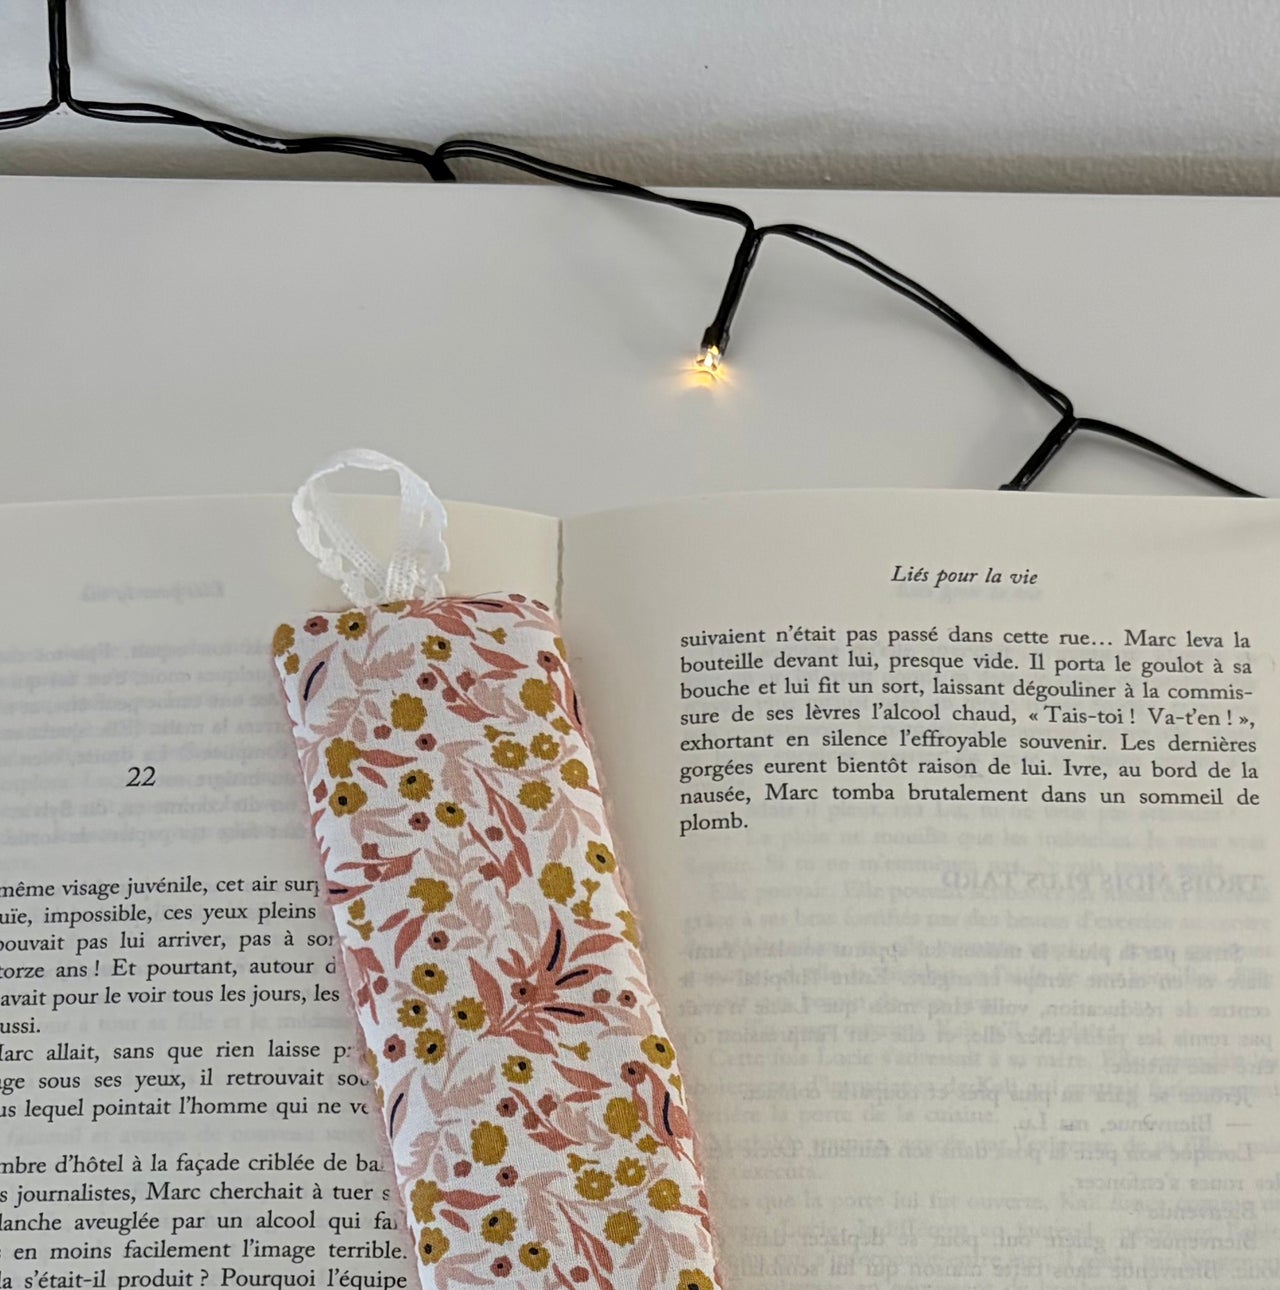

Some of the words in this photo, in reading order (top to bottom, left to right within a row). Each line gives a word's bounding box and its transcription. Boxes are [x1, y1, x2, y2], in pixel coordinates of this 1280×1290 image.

[890, 565, 930, 583] Liés
[933, 569, 979, 589] pour
[984, 567, 1003, 584] la
[1009, 568, 1039, 585] vie
[680, 628, 766, 648] suivaient
[776, 624, 837, 643] n'était
[845, 629, 878, 648] pas
[887, 626, 939, 648] passé
[948, 624, 993, 644] dans
[1003, 631, 1049, 645] cette
[1123, 628, 1177, 648] Marc
[1185, 630, 1225, 648] leva
[1233, 630, 1251, 649] la
[680, 651, 764, 674] bouteille
[773, 650, 839, 669] devant
[847, 649, 880, 671] lui,
[888, 655, 965, 674] presque
[972, 651, 1019, 670] vide.
[1028, 652, 1046, 671] Il
[1054, 657, 1106, 677] porta
[1114, 654, 1132, 673] le
[1140, 655, 1204, 679] goulot
[1212, 657, 1224, 674] à
[1232, 662, 1253, 675] sa
[679, 678, 750, 700] bouche
[758, 680, 778, 695] et
[783, 676, 810, 695] lui
[817, 675, 841, 694] fit
[847, 682, 874, 694] un
[881, 680, 925, 698] sort,
[932, 676, 1006, 696] laissant
[1012, 678, 1117, 703] dégouliner
[1124, 682, 1136, 699] à
[1142, 681, 1160, 699] la
[1167, 683, 1253, 701] commis-
[680, 732, 775, 752] exhortant
[785, 735, 810, 748] en
[822, 728, 888, 747] silence
[899, 728, 1008, 754] l'effroyable
[1019, 733, 1107, 751] souvenir.
[1120, 732, 1156, 752] Les
[1167, 733, 1257, 753] dernières
[125, 765, 156, 788] 22
[679, 759, 754, 784] gorgées
[763, 759, 828, 775] eurent
[836, 755, 909, 774] bientôt
[917, 757, 978, 775] raison
[987, 756, 1011, 776] de
[1020, 757, 1053, 776] lui.
[1062, 758, 1108, 781] Ivre,
[1118, 765, 1142, 778] au
[1150, 759, 1198, 779] bord
[1207, 760, 1232, 779] de
[1241, 761, 1259, 780] la
[679, 785, 752, 806] nausée,
[764, 782, 819, 801] Marc
[831, 781, 896, 801] tomba
[907, 782, 1029, 803] brutalement
[1041, 784, 1087, 804] dans
[1099, 791, 1126, 804] un
[1139, 787, 1224, 806] sommeil
[1236, 787, 1260, 806] de
[679, 810, 749, 838] plomb.
[61, 879, 121, 901] visage
[123, 874, 209, 901] juvénile,
[215, 878, 245, 893] cet
[251, 875, 279, 892] air
[43, 903, 153, 929] impossible,
[163, 907, 193, 921] ces
[201, 907, 249, 926] yeux
[257, 900, 317, 925] pleins
[51, 992, 100, 1012] pour
[103, 985, 122, 1005] le
[127, 986, 167, 1004] voir
[172, 988, 214, 1003] tous
[219, 983, 246, 1002] les
[249, 984, 307, 1008] jours,
[313, 983, 340, 1002] les
[46, 1042, 100, 1064] allait,
[113, 1046, 155, 1060] sans
[167, 1045, 203, 1065] que
[215, 1040, 255, 1058] rien
[267, 1038, 321, 1058] laisse
[13, 1247, 38, 1261] en
[49, 1241, 112, 1260] moins
[123, 1238, 232, 1259] facilement
[241, 1238, 316, 1265] l'image
[328, 1241, 410, 1260] terrible.
